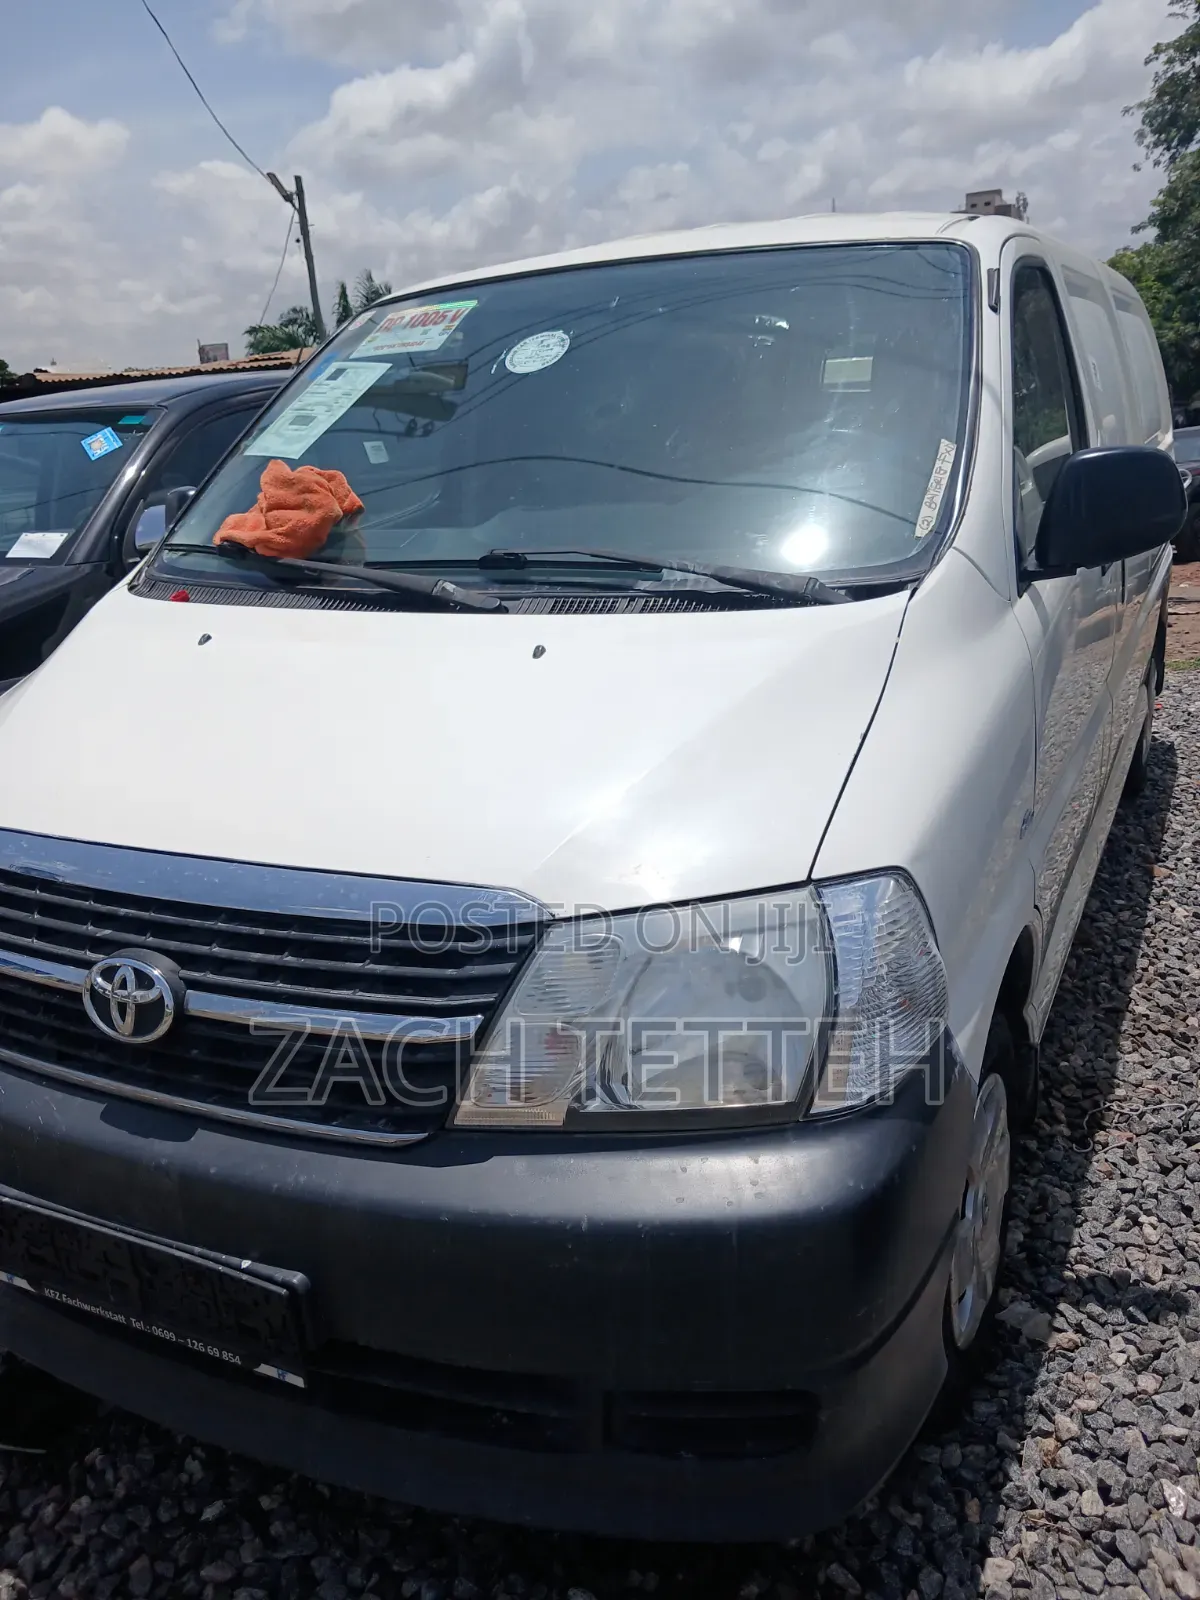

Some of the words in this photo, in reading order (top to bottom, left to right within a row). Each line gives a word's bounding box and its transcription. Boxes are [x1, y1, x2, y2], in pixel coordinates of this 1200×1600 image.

[449, 307, 466, 324] V
[44, 1287, 61, 1302] KFZ
[62, 1294, 126, 1324] Fachwerkstatt
[129, 1317, 151, 1333] Tel.:
[152, 1325, 176, 1342] 0699
[186, 1338, 206, 1353] 126
[207, 1344, 220, 1358] 69
[222, 1351, 242, 1366] 854
